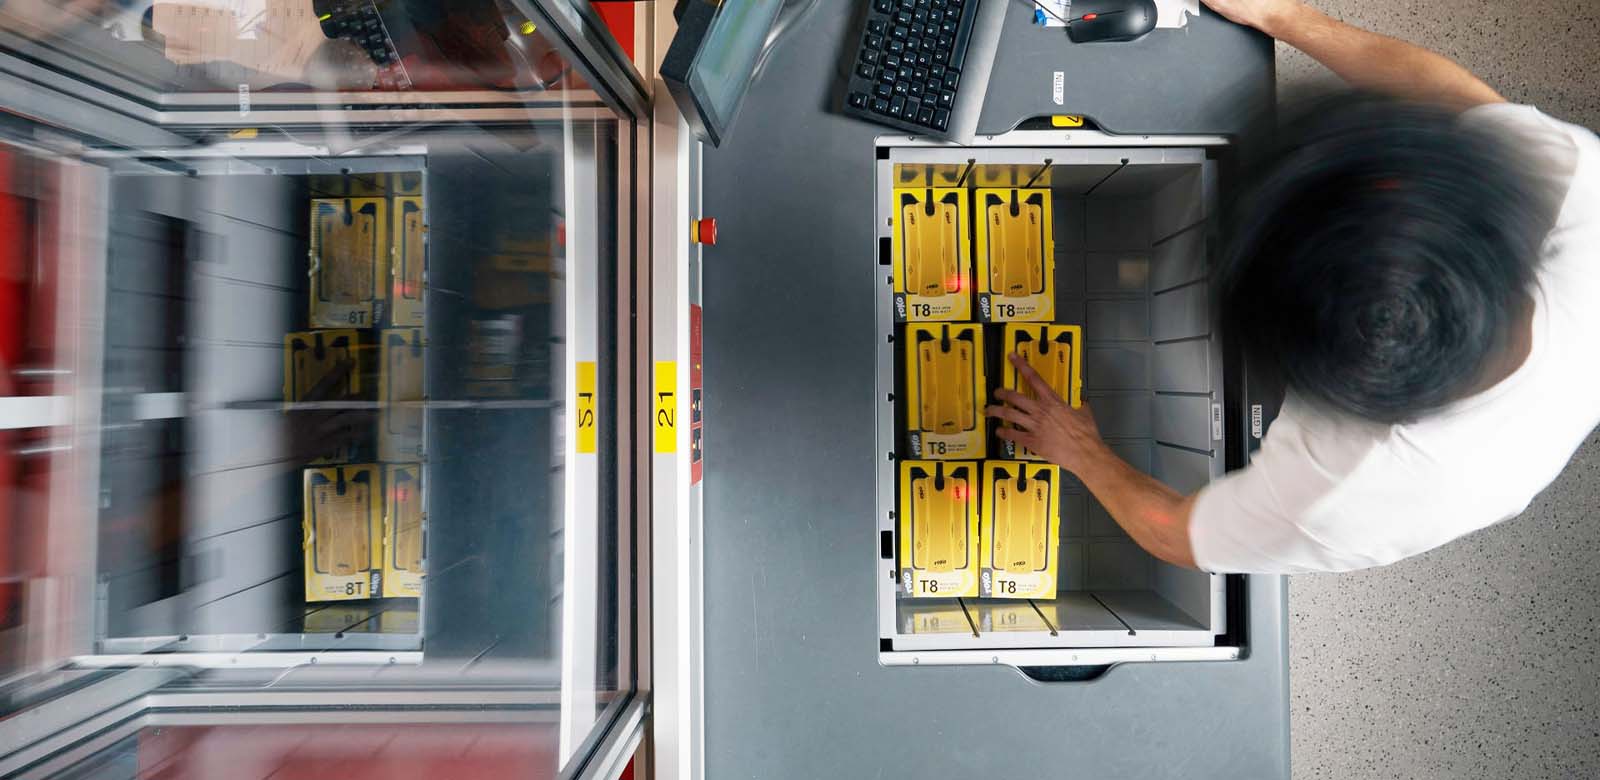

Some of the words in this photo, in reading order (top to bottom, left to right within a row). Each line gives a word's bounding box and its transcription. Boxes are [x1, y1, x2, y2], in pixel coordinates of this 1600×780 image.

[896, 296, 906, 318] TOKO
[912, 304, 931, 318] T8
[980, 296, 990, 318] TOKO
[996, 304, 1016, 318] T8
[658, 391, 674, 428] 21
[912, 434, 921, 456] TOKO
[928, 442, 946, 455] T8
[903, 572, 913, 594] TOKO
[920, 580, 938, 593] T8
[982, 572, 992, 594] TOKO
[998, 580, 1016, 594] T8
